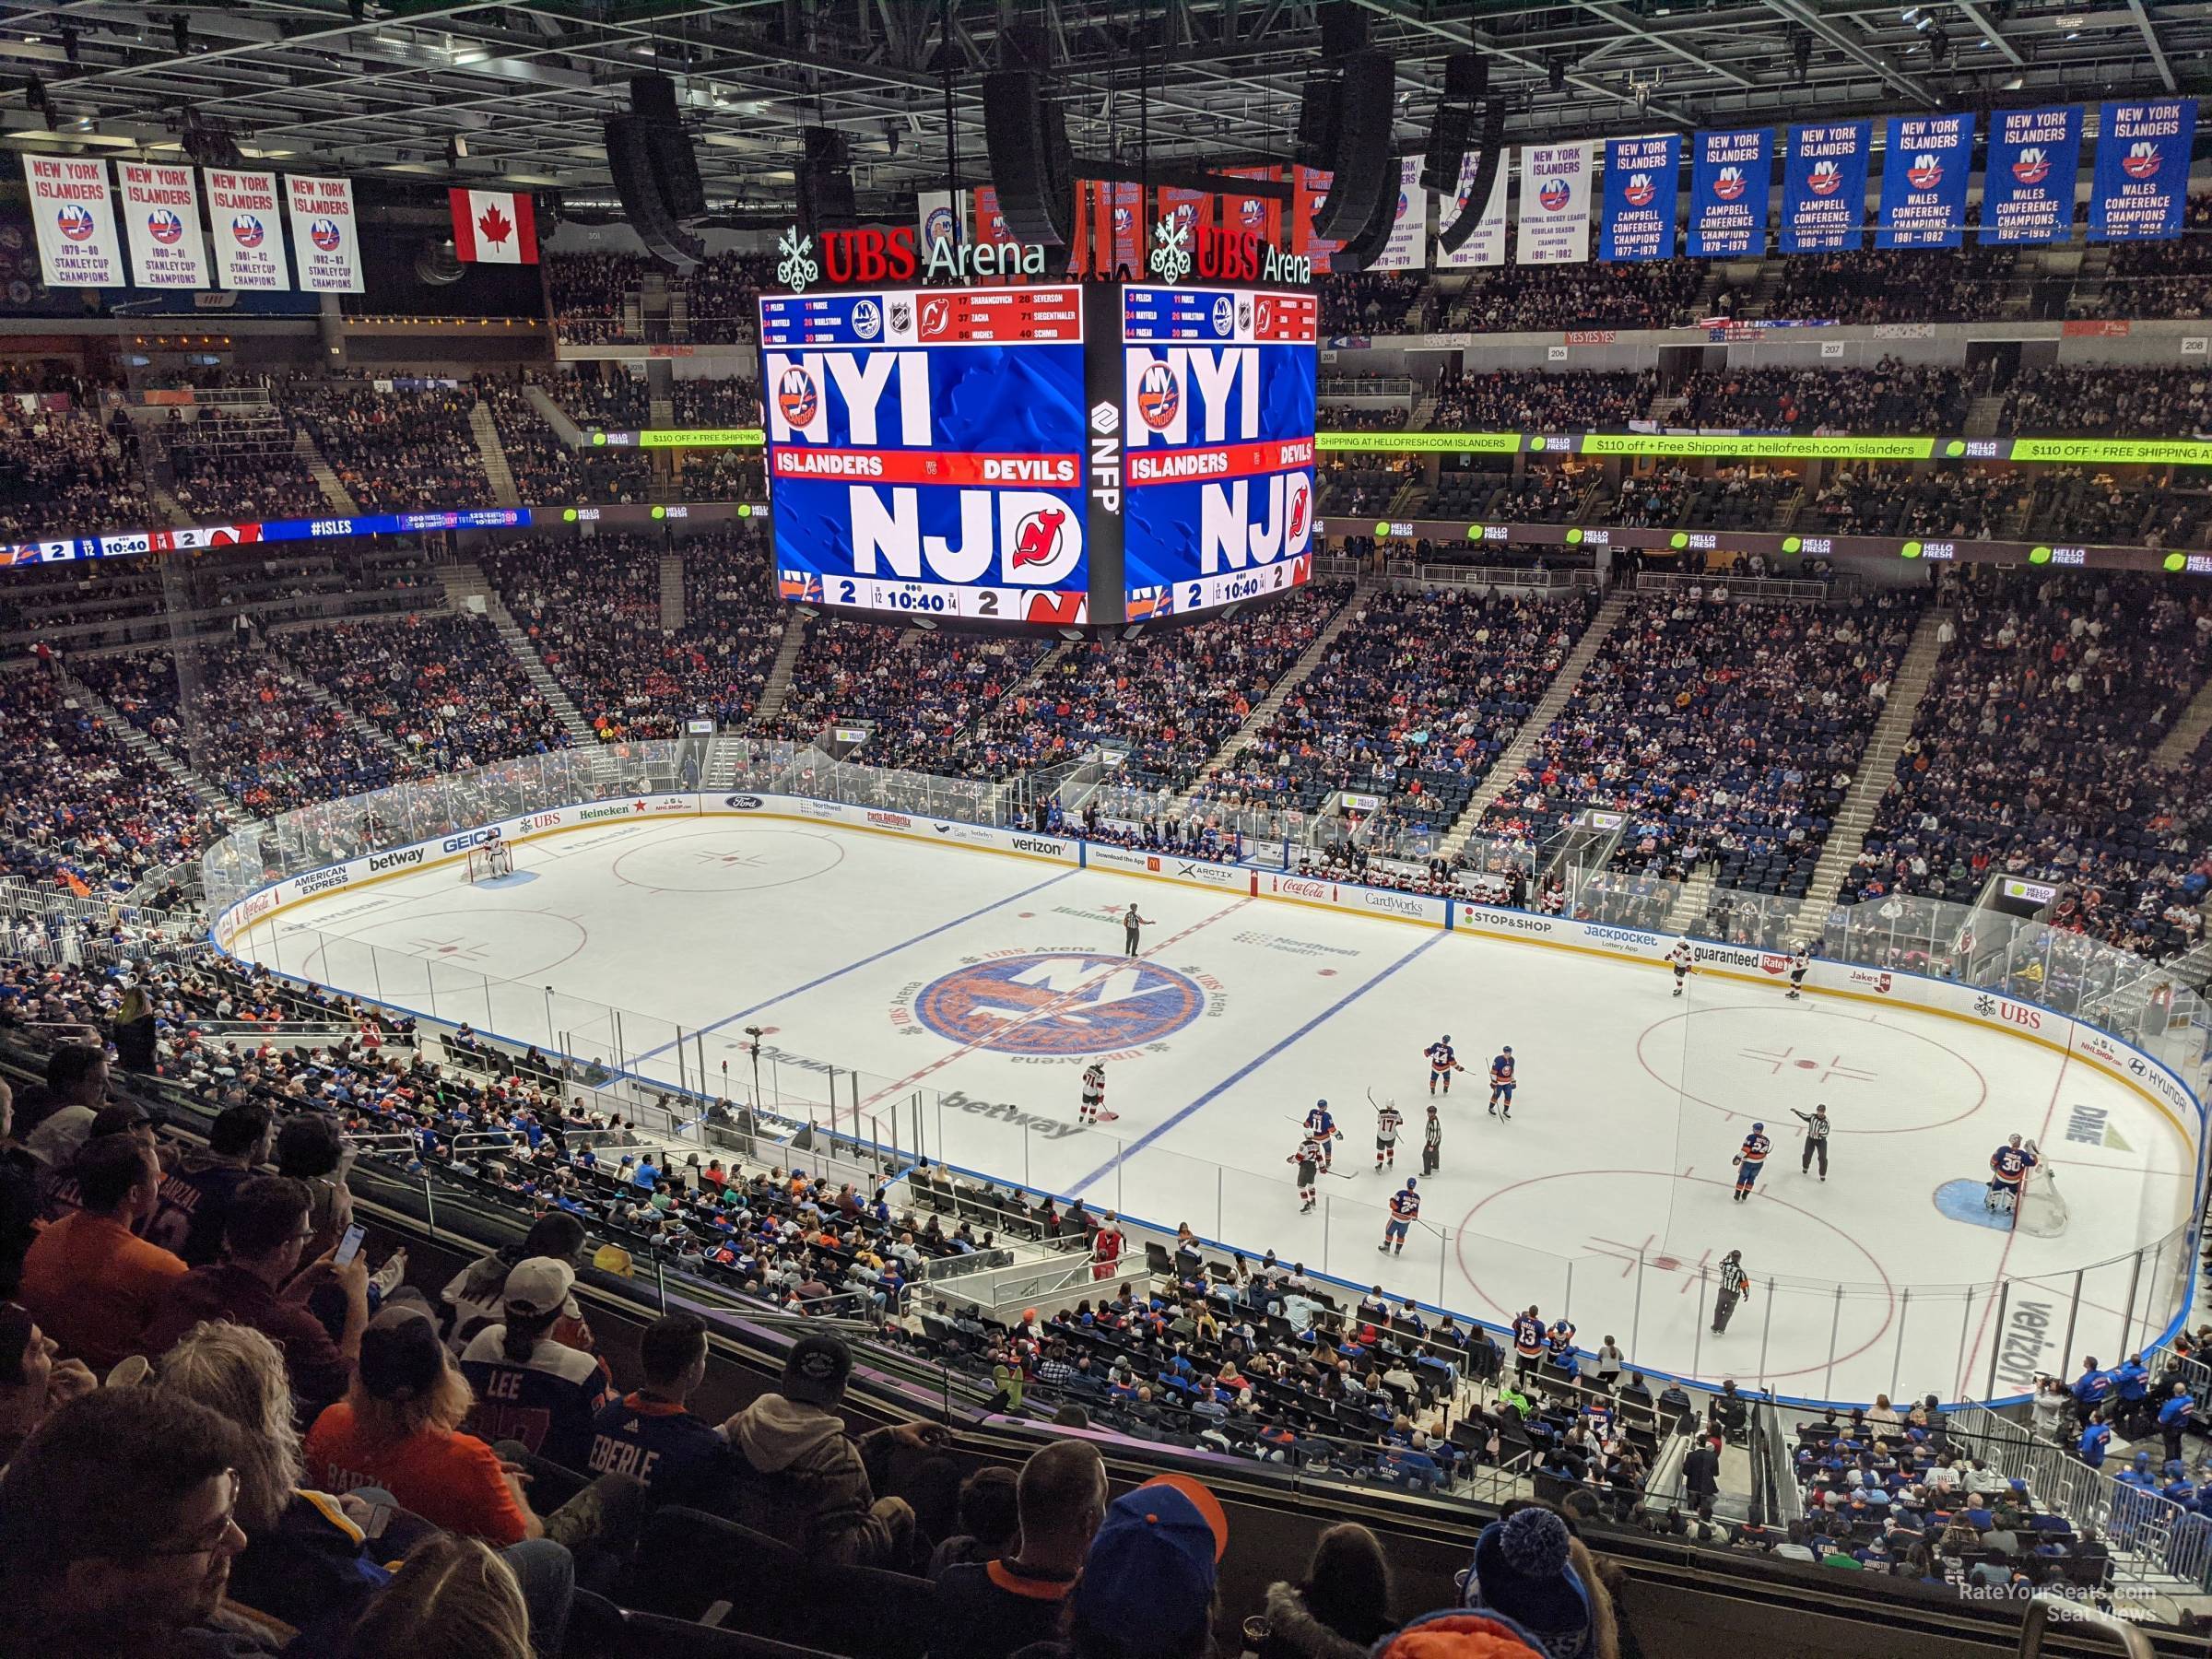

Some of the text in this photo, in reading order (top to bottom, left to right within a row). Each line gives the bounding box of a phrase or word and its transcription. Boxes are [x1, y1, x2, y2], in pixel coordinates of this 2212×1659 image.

[2006, 112, 2067, 128] NEW YORK
[2116, 105, 2180, 122] NEW YORK
[1802, 126, 1856, 142] NEW YORK
[1901, 119, 1959, 135] NEW YORK
[2114, 122, 2179, 137] ISLANDERS
[1708, 134, 1759, 148] NEW YORK
[1534, 147, 1581, 162] NEW YORK
[1618, 141, 1666, 156] NEW YORK
[36, 182, 104, 200] ISLANDERS
[128, 186, 191, 205] ISLANDERS
[2013, 188, 2044, 200] WALES
[2123, 183, 2156, 195] WALES
[214, 192, 273, 210] ISLANDERS
[294, 197, 348, 215] ISLANDERS
[1800, 199, 1845, 211] CAMPBELL
[1907, 194, 1937, 205] WALES
[2105, 196, 2170, 210] CONFERENCE
[1706, 205, 1748, 216] CAMPBELL
[1892, 206, 1951, 218] CONFERENCE
[1996, 201, 2058, 214] CONFERENCE
[1568, 213, 1587, 221] LEAGUE
[1618, 210, 1659, 221] CAMPBELL
[1700, 216, 1753, 229] CONFERENCE
[1794, 211, 1850, 224] CONFERENCE
[1613, 221, 1663, 233] CONFERENCE
[821, 228, 1045, 283] UBS Arena
[1193, 225, 1258, 281] UBS
[1263, 243, 1311, 284] Arena
[55, 258, 109, 268] STANLEY CUP
[146, 260, 195, 271] STANLEY CUP
[60, 271, 109, 282] CHAMPIONS
[150, 273, 195, 284] CHAMPIONS
[959, 297, 968, 305] 17
[1033, 294, 1063, 303] SEVERSON
[1135, 294, 1151, 302] PELECH
[971, 313, 989, 322] ZACHA
[1034, 312, 1076, 321] SIEGENTHALER
[971, 330, 994, 338] HUGHES
[1034, 329, 1057, 337] SCHMID
[1569, 331, 1615, 342] YES YES YES
[1551, 349, 1564, 359] 206
[1825, 346, 1841, 354] 207
[767, 349, 933, 445] NYI
[1126, 347, 1259, 447] NYI
[1321, 438, 1359, 446] SHIPPING
[1374, 438, 1505, 448] HELLOFRESH.COM/ISLANDERS
[1597, 441, 1915, 454] $110 off Free Shipping at hellofresh.com/islanders
[2031, 445, 2197, 459] $110 OFF FREE SHIPPING
[776, 453, 1075, 481] ISLANDERS DEVILS
[1132, 452, 1228, 479] ISLANDERS
[1281, 442, 1312, 465] DEVILS
[1091, 439, 1120, 512] NFP
[312, 520, 351, 535] #ISLES
[1201, 471, 1312, 574] NJD
[849, 485, 1083, 585] NJD
[52, 534, 194, 558] 2 10:40 2
[2053, 548, 2085, 557] HELLO
[2052, 556, 2084, 564] FRESH
[840, 580, 998, 615] 2 12 10:40 14 2
[1188, 579, 1258, 607] 2 10:40
[732, 796, 757, 810] Ford
[813, 802, 841, 812] Northwell
[580, 804, 629, 819] Heineken
[813, 809, 832, 818] Health
[534, 812, 560, 828] UBS
[867, 811, 883, 822] Parts
[884, 813, 912, 828] Authority
[1012, 838, 1061, 856] verizon
[369, 848, 424, 872] betway
[1096, 851, 1123, 862] Download
[1134, 857, 1145, 865] App
[294, 865, 347, 888] AMERICAN
[1196, 867, 1232, 878] ARCTIX
[301, 876, 348, 895] EXPRESS
[1283, 878, 1324, 900] Coca-Cola
[1365, 892, 1423, 912] CardWorks
[1401, 909, 1422, 917] Acquiring
[1475, 912, 1551, 933] STOP&SHOP
[984, 945, 1096, 959] UBS Arena
[1272, 935, 1359, 958] Northwell
[1602, 940, 1623, 950] Lottery
[1694, 946, 1784, 970] guaranteed Rate
[1850, 971, 1878, 983] Jake's
[1195, 974, 1229, 1018] UBS Arena
[891, 981, 923, 1026] UBS Arena
[1999, 1001, 2041, 1030] UBS
[1432, 1052, 1448, 1064] 44
[1085, 1074, 1096, 1087] 71
[2149, 1071, 2186, 1113] HYUNDAI
[940, 1090, 1088, 1140] betway
[1312, 1118, 1322, 1133] 11
[1382, 1119, 1394, 1132] 17
[2065, 1104, 2108, 1147] DIME
[1751, 1142, 1769, 1153] 24
[2003, 1158, 2021, 1171] 30
[1401, 1202, 1417, 1213] 26
[1519, 1326, 1536, 1346] 13
[1997, 1300, 2053, 1386] verizon
[488, 1370, 524, 1399] LEE
